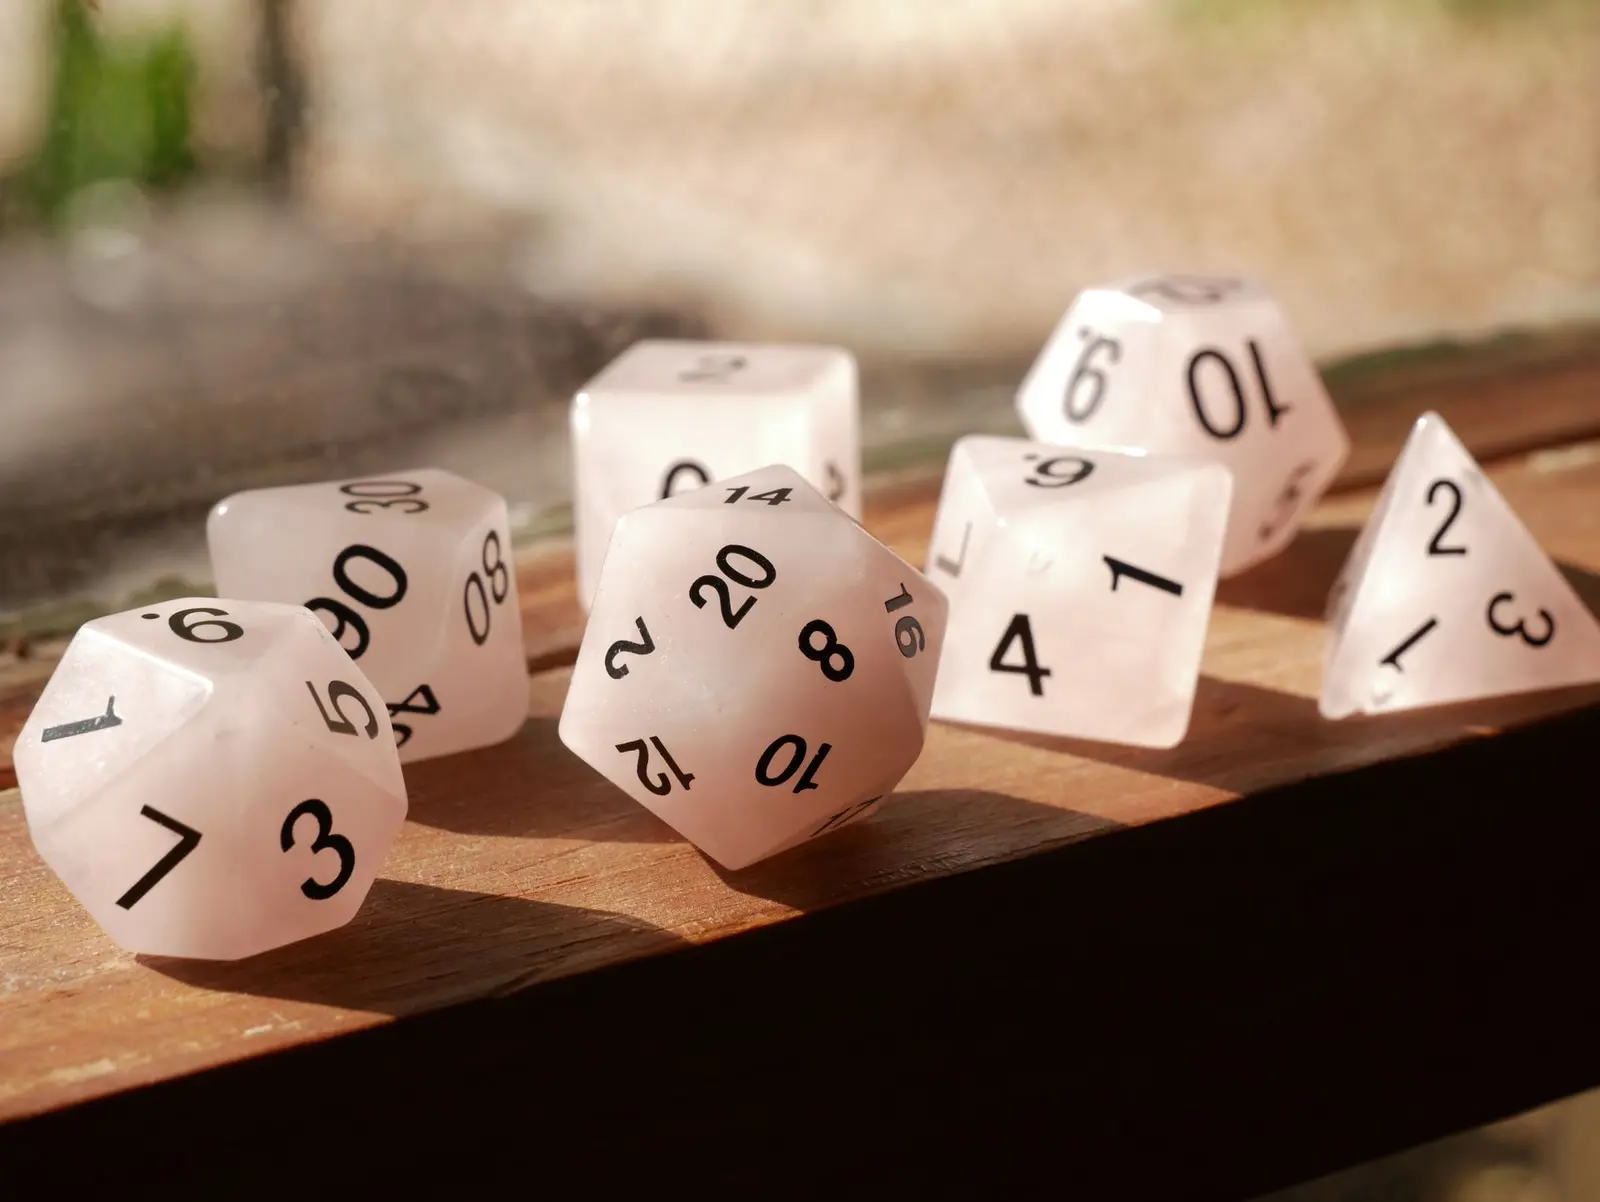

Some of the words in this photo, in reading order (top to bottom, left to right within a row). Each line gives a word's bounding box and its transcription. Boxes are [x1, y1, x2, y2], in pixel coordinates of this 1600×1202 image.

[1185, 337, 1291, 440] 10
[339, 481, 431, 515] 30
[724, 486, 794, 506] 14
[1424, 479, 1467, 556] 2
[303, 544, 408, 661] 90
[689, 544, 777, 629] 20
[1102, 554, 1184, 597] 1
[604, 616, 656, 680] 2
[798, 619, 856, 683] 8
[884, 582, 926, 658] 16
[1378, 618, 1440, 673] 1
[1486, 592, 1557, 648] 3
[988, 612, 1053, 698] 4
[40, 694, 123, 743] 1
[304, 680, 379, 741] 5
[614, 735, 696, 797] 12
[754, 733, 833, 794] 10
[114, 804, 204, 911] 7
[279, 798, 357, 901] 3
